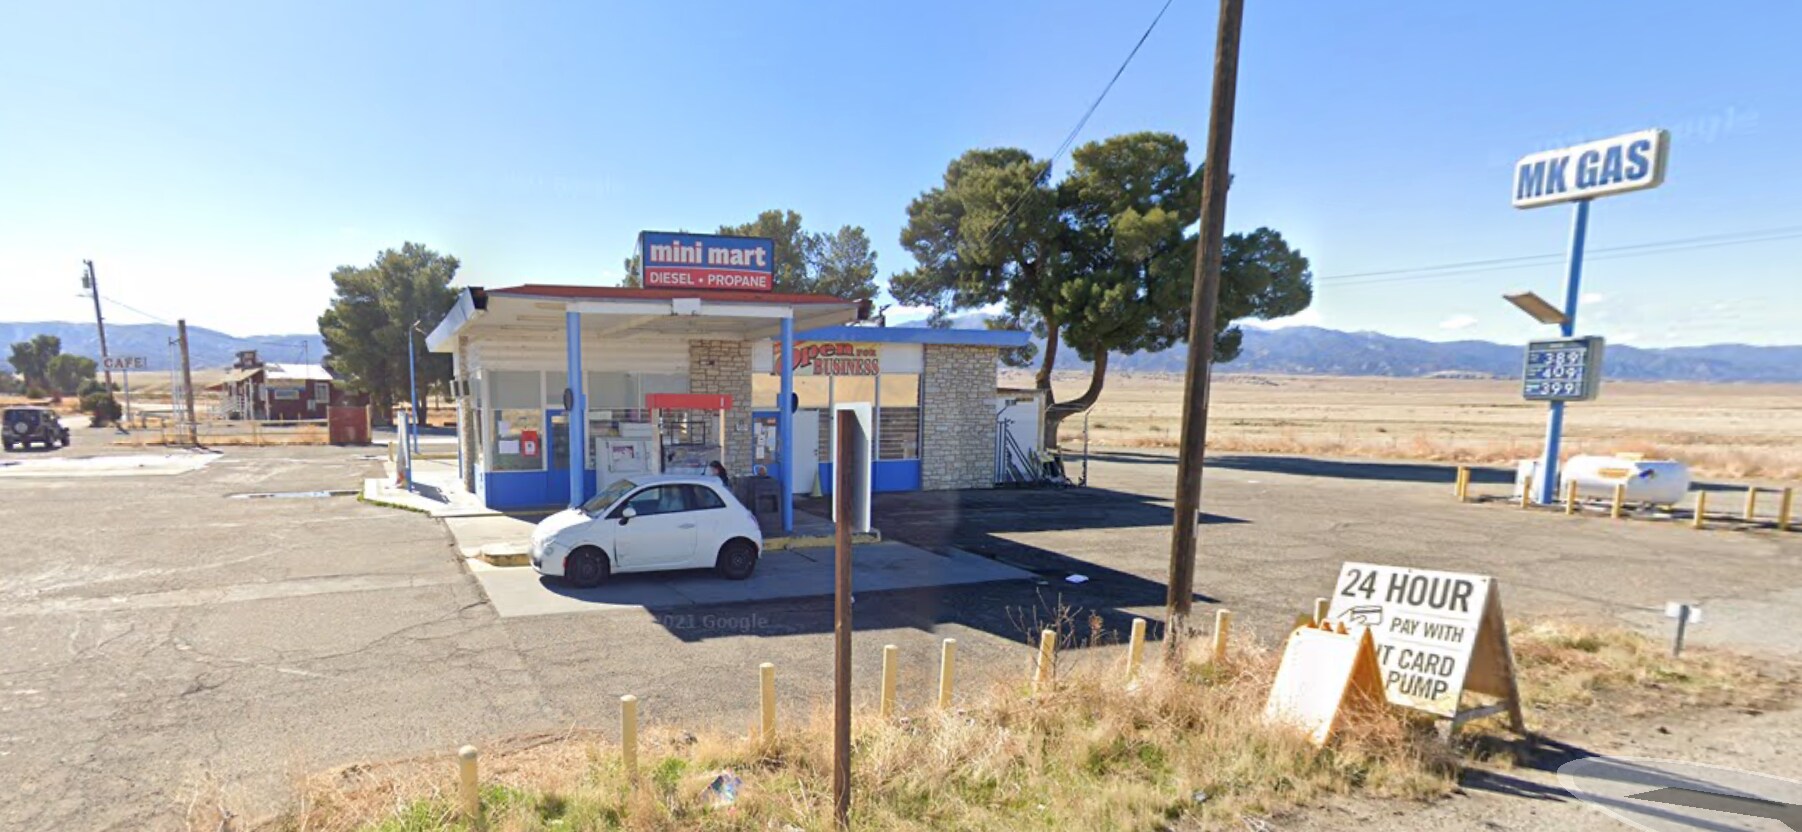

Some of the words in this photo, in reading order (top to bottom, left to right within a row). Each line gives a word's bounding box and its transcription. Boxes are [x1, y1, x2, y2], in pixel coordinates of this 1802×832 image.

[1517, 156, 1570, 199] MK
[1576, 139, 1650, 189] GAS
[650, 240, 702, 264] mini
[708, 246, 766, 267] mart
[650, 271, 695, 285] DIESEL
[708, 274, 766, 287] PROPANE
[813, 358, 880, 376] BUSINESS
[1341, 569, 1378, 599] 24
[1385, 573, 1473, 612] HOUR
[1390, 617, 1420, 636] PAY
[1424, 622, 1465, 643] WITH
[1398, 649, 1455, 677] CARD
[1386, 671, 1448, 700] PUMP
